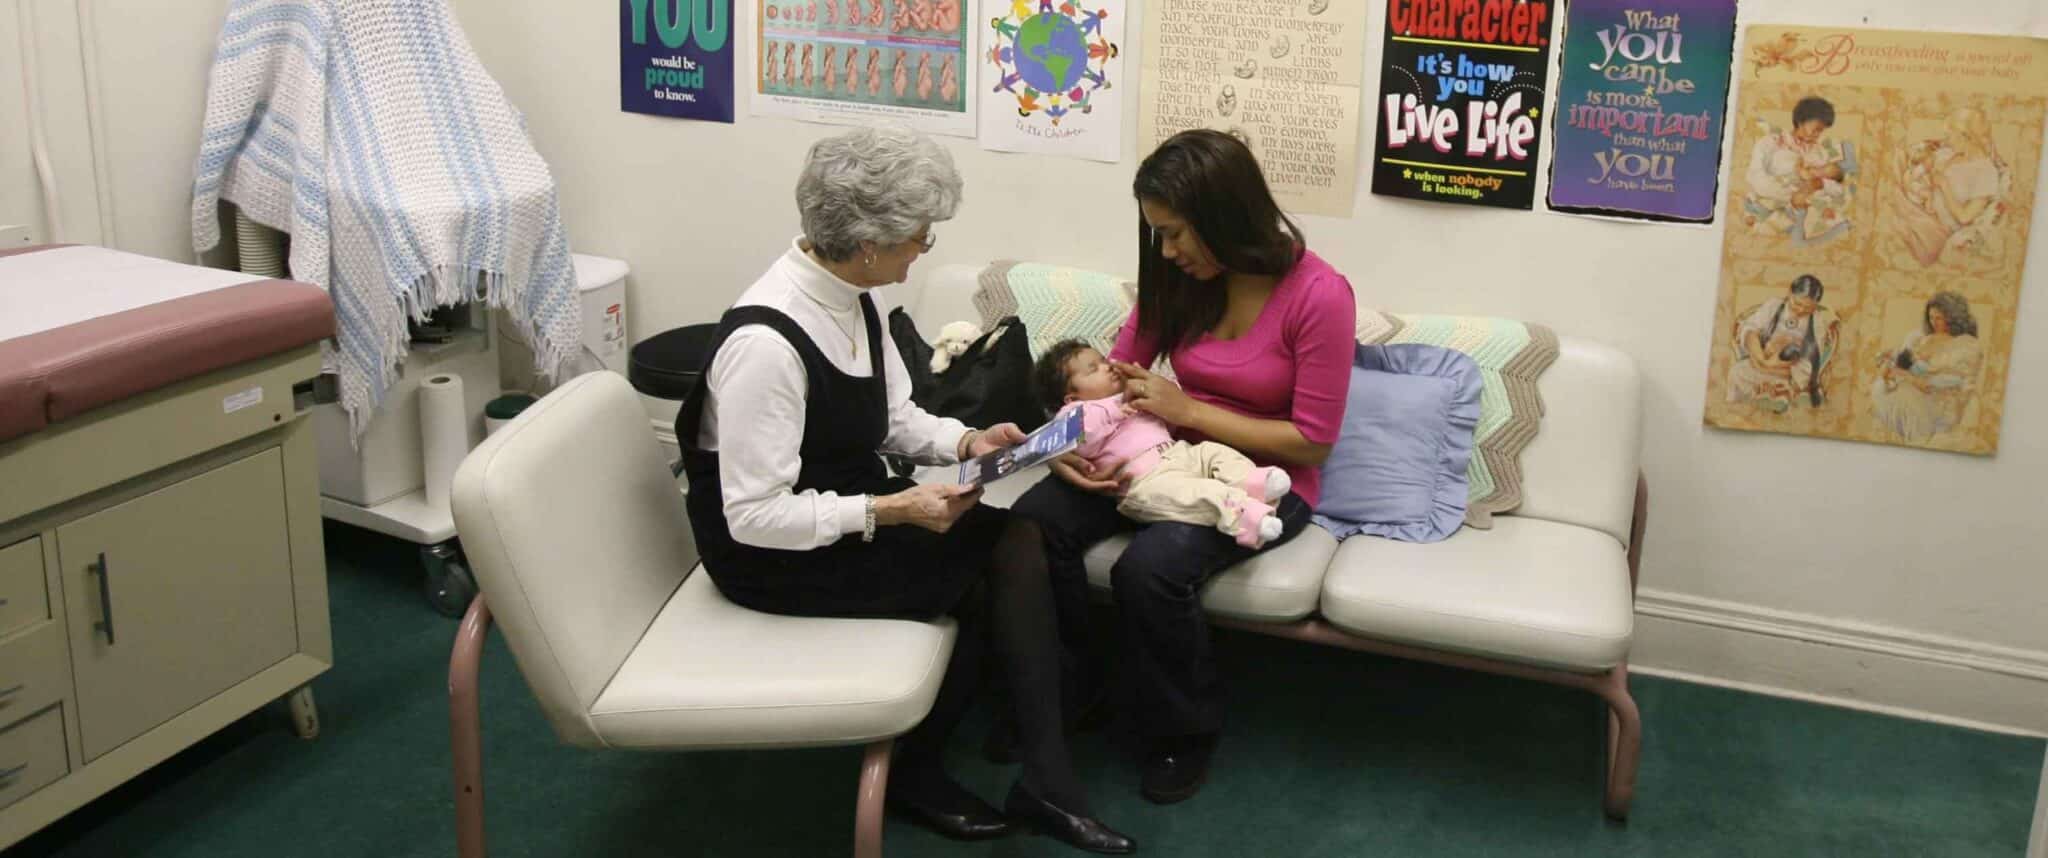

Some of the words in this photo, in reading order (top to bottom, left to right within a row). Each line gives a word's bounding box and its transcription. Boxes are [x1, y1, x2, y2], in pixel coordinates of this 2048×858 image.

[630, 0, 728, 52] YOU
[1624, 9, 1681, 32] What
[1589, 24, 1683, 71] you
[651, 56, 681, 69] would
[683, 56, 696, 70] be
[1417, 53, 1453, 75] It's
[1457, 54, 1515, 82] how
[645, 65, 704, 91] proud
[1436, 75, 1485, 101] you
[1603, 63, 1657, 85] can
[1656, 66, 1696, 94] be
[654, 88, 665, 99] to
[666, 88, 697, 103] know.
[1587, 90, 1601, 105] is
[1605, 90, 1662, 108] more
[1386, 92, 1460, 153] Live
[1567, 103, 1712, 140] important
[1613, 132, 1647, 147] than
[1648, 137, 1687, 154] what
[1586, 147, 1676, 185] you
[1414, 171, 1446, 183] when
[1448, 173, 1503, 191] nobody
[1422, 181, 1433, 193] is
[1435, 184, 1484, 199] looking.
[1607, 177, 1639, 192] have
